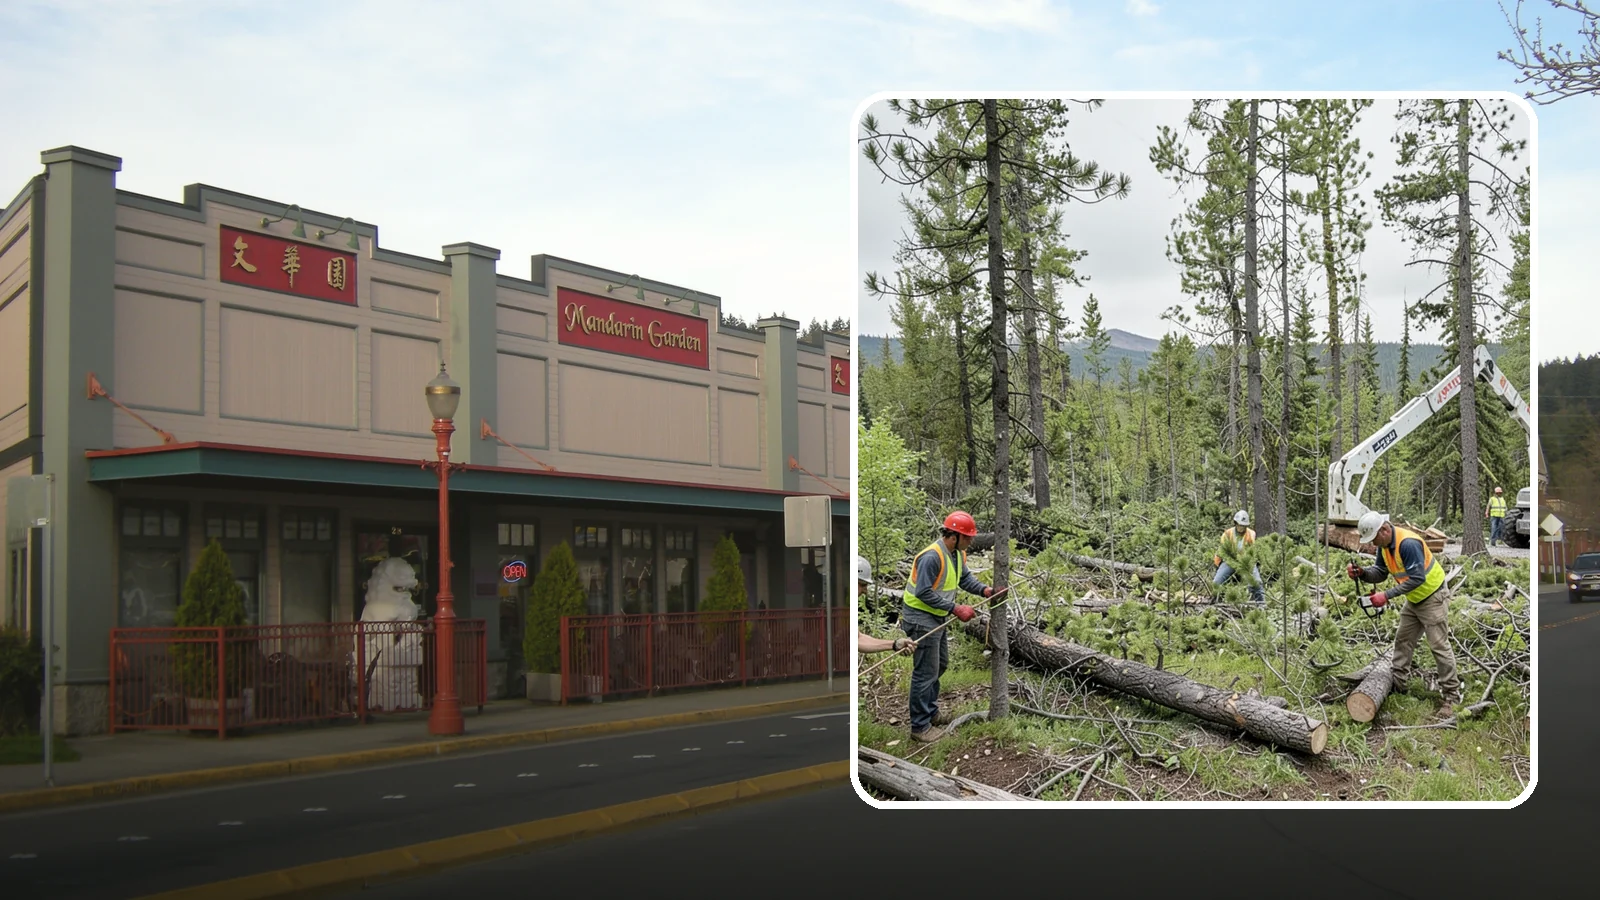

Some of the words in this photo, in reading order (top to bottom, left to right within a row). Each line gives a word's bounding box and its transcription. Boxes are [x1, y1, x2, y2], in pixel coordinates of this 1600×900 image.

[230, 235, 346, 291] 文華園
[564, 302, 644, 340] Mandarin
[647, 320, 702, 352] Garden
[503, 565, 527, 578] OPEN
